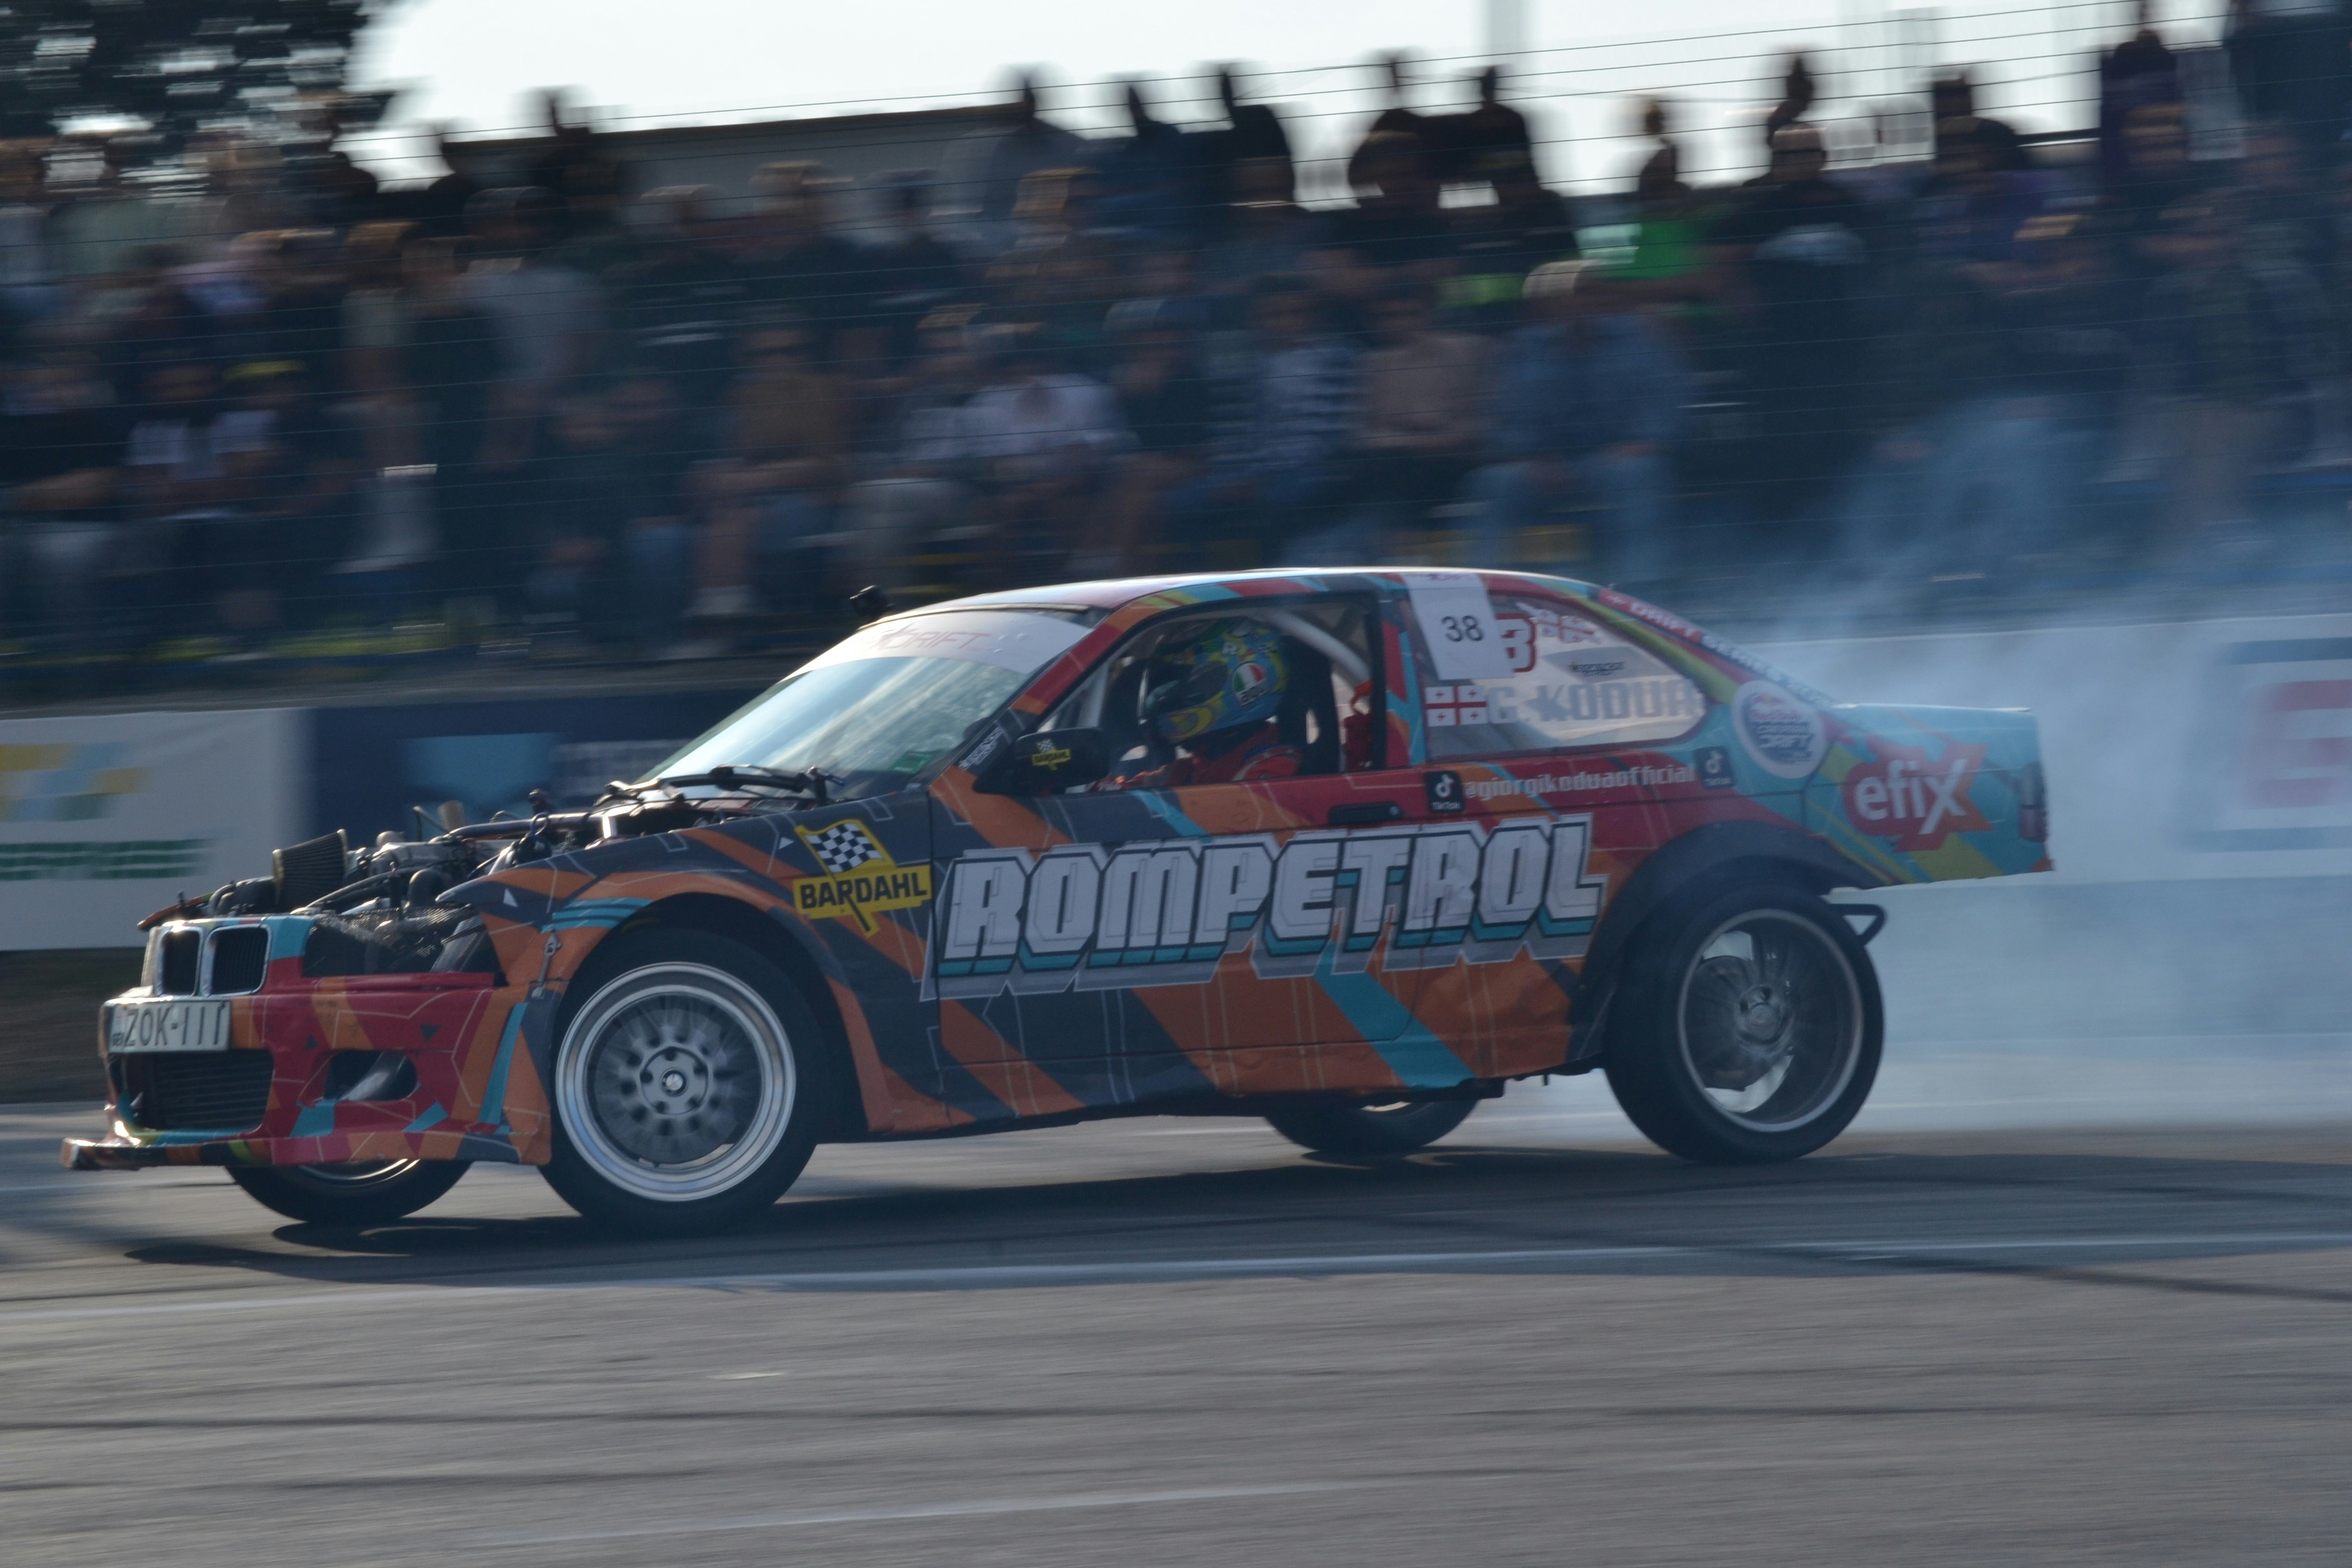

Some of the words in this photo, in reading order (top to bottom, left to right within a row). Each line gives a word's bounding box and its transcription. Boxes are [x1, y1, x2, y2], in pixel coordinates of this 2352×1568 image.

[1441, 615, 1484, 642] 38
[799, 871, 927, 910] BARDAHL
[930, 817, 1606, 984] ROMPETROL
